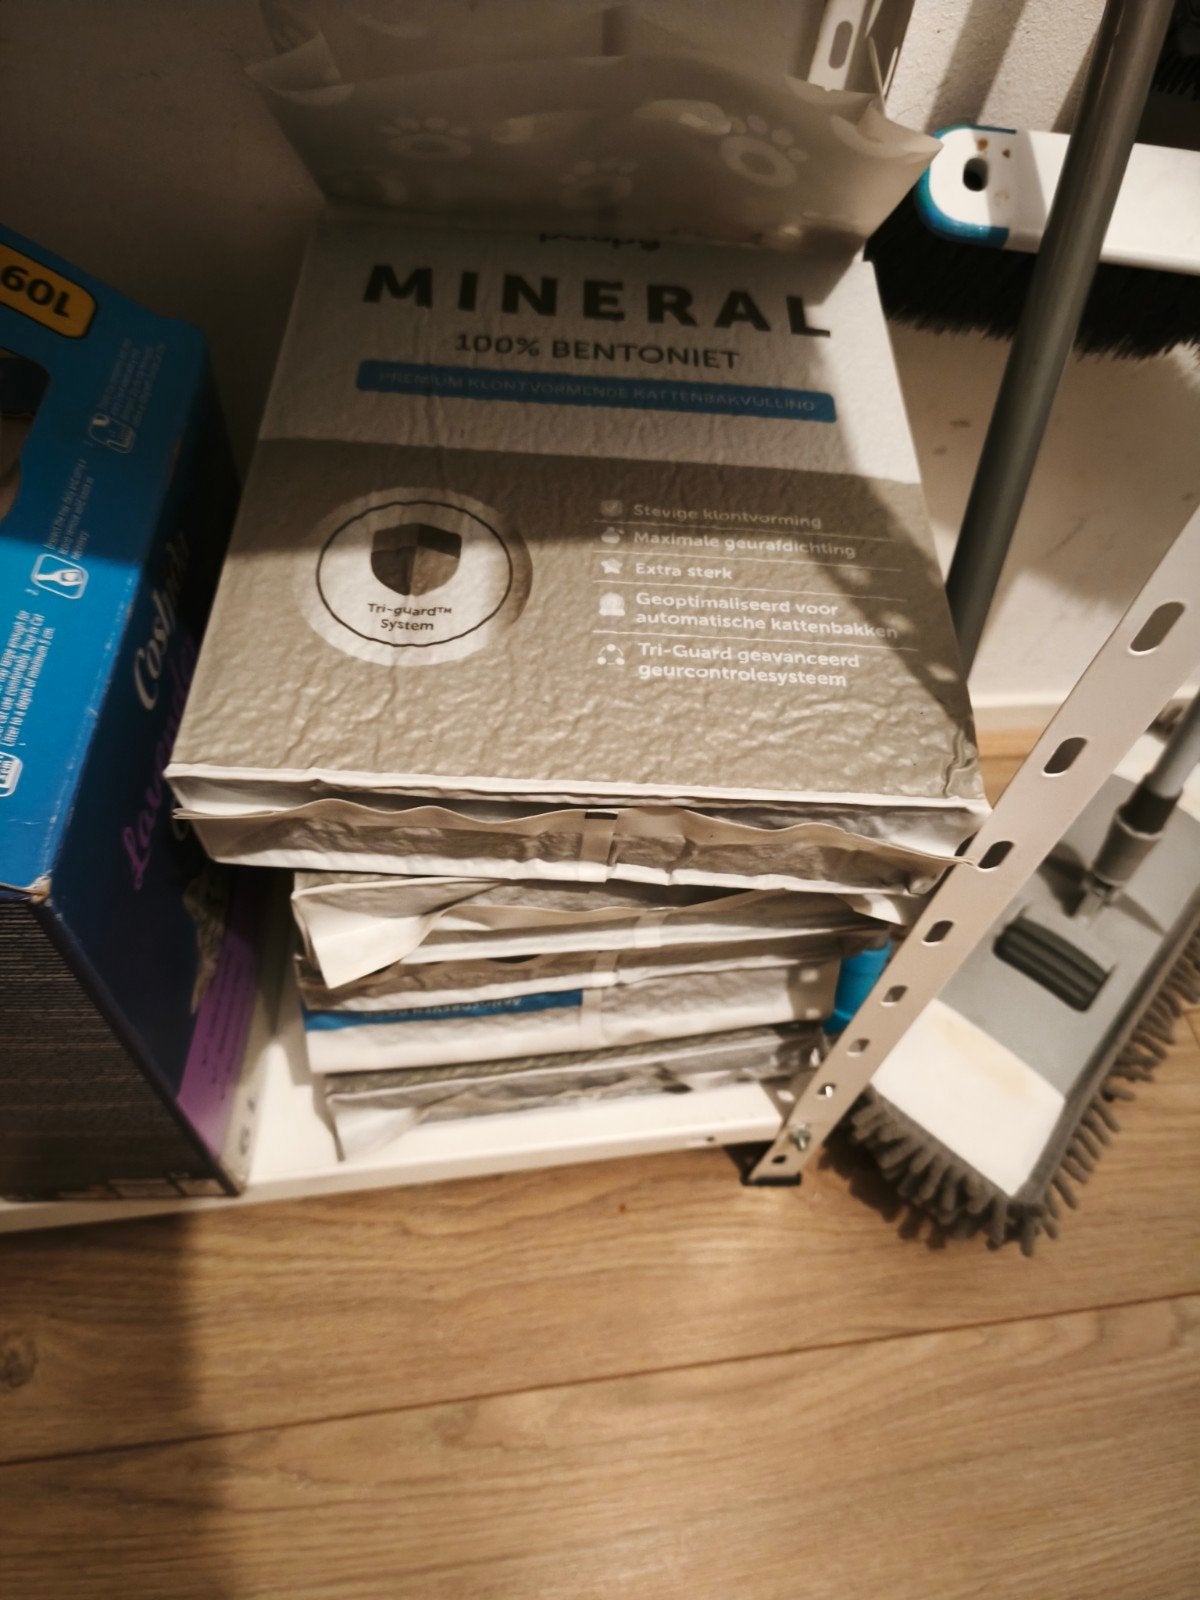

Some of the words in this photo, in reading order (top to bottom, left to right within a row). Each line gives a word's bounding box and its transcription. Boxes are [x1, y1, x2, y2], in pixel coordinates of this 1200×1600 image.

[1, 264, 70, 318] 60L
[362, 263, 830, 336] MINERAL
[454, 333, 540, 357] 100%
[551, 338, 740, 369] BENTONIET
[379, 371, 464, 390] PREMIUM
[468, 373, 628, 398] KLONTVORMENDE
[633, 387, 816, 412] KATTENBAKVULLING
[633, 504, 698, 522] Stevige
[702, 508, 822, 530] klontvorming
[633, 531, 720, 549] Maximale
[724, 536, 856, 559] geurafdichting
[635, 562, 682, 578] Extra
[687, 564, 733, 580] sterk
[635, 591, 791, 613] Geoptimaliseerd
[794, 603, 839, 616] voor
[380, 619, 435, 633] System
[636, 610, 767, 630] automatische
[770, 617, 898, 639] kattenbakken
[637, 642, 733, 661] Tri-Guard
[737, 646, 860, 668] geavanceerd
[637, 663, 847, 687] geurcontrolesysteem
